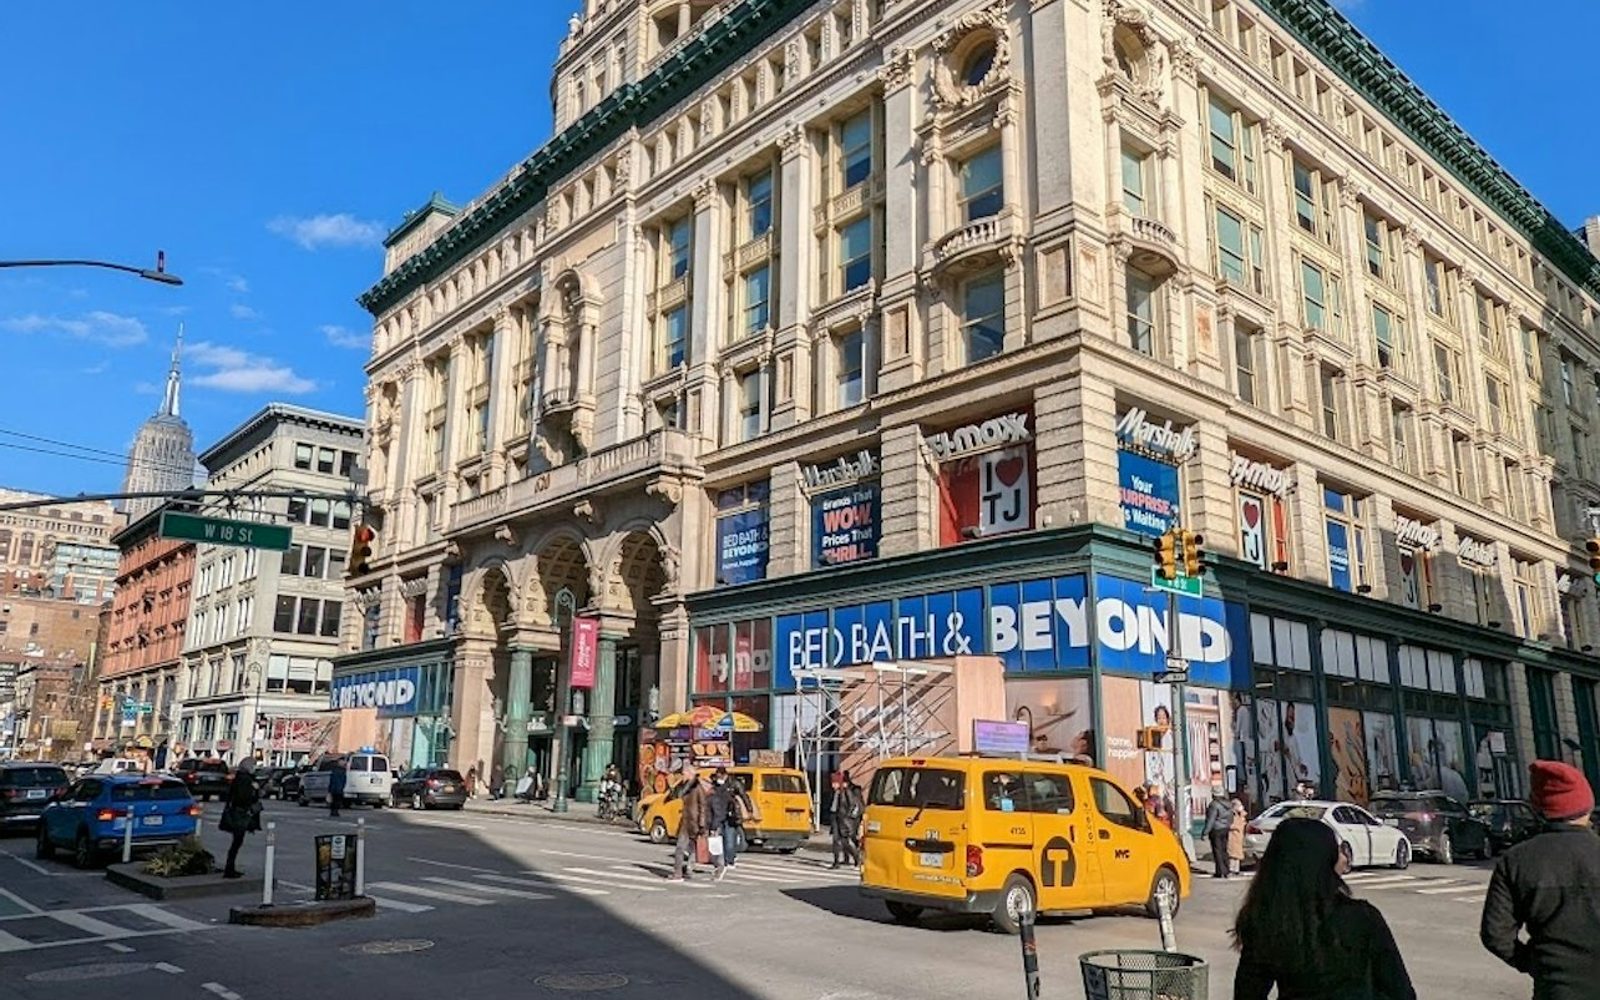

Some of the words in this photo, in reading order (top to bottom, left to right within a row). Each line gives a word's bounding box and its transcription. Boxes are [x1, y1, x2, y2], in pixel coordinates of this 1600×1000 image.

[1116, 407, 1197, 458] Marshalls
[803, 450, 880, 488] Marshalls
[1131, 474, 1154, 494] Your
[982, 489, 1021, 525] TJ
[1132, 510, 1166, 532] Waiting
[205, 524, 215, 538] W
[220, 525, 234, 541] 18
[239, 528, 253, 543] St
[723, 533, 738, 549] BED
[822, 533, 851, 548] Prices
[851, 527, 873, 540] That
[723, 541, 769, 560] BEYOND
[790, 627, 844, 673] BED
[851, 613, 935, 663] BATH
[942, 611, 972, 656] &
[991, 597, 1233, 663] BEYOND
[340, 679, 415, 709] BEYOND
[1114, 849, 1131, 859] NYC
